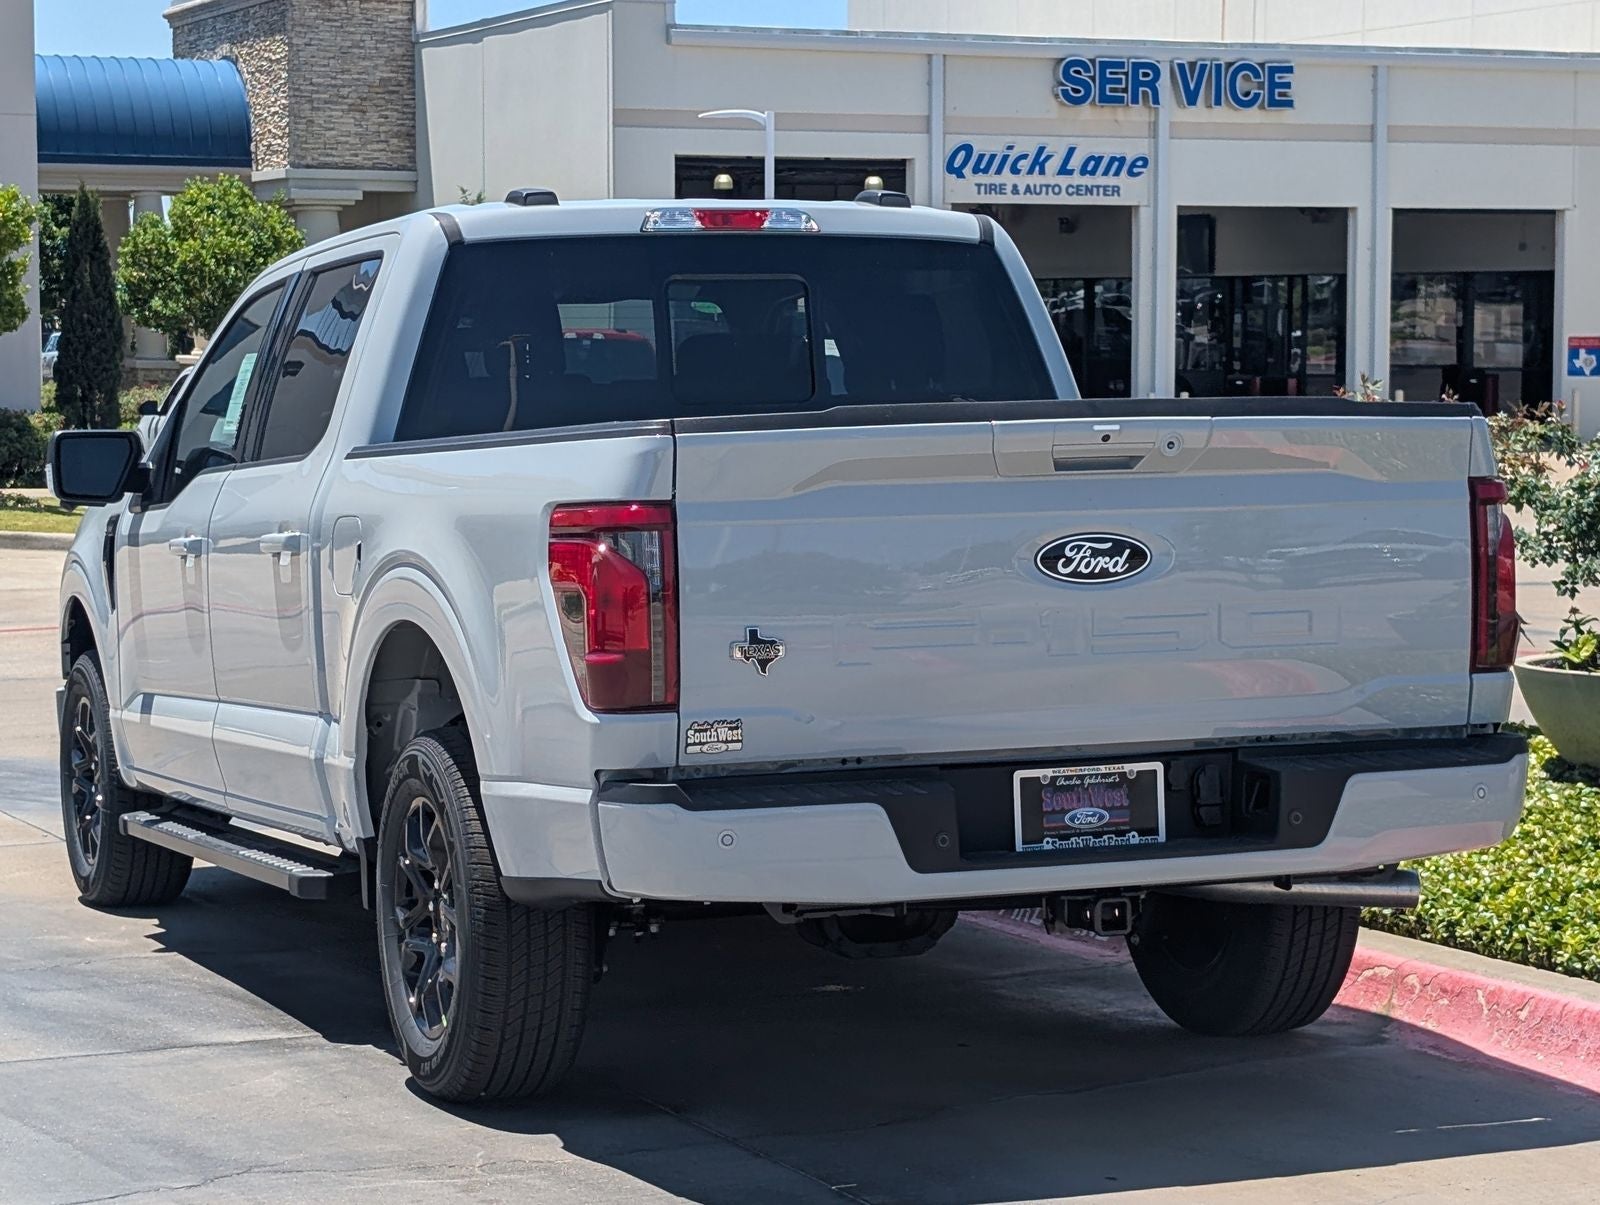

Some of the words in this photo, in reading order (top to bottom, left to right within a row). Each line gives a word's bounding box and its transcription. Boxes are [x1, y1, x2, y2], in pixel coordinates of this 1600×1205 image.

[945, 143, 1054, 179] Quick
[1056, 146, 1149, 178] Lane
[974, 182, 1007, 196] TIRE
[1010, 183, 1020, 196] &
[1023, 183, 1062, 196] AUTO
[1066, 184, 1121, 198] CENTER
[1057, 541, 1130, 576] Ford
[737, 643, 782, 658] TEXAS
[1075, 811, 1099, 824] Ford
